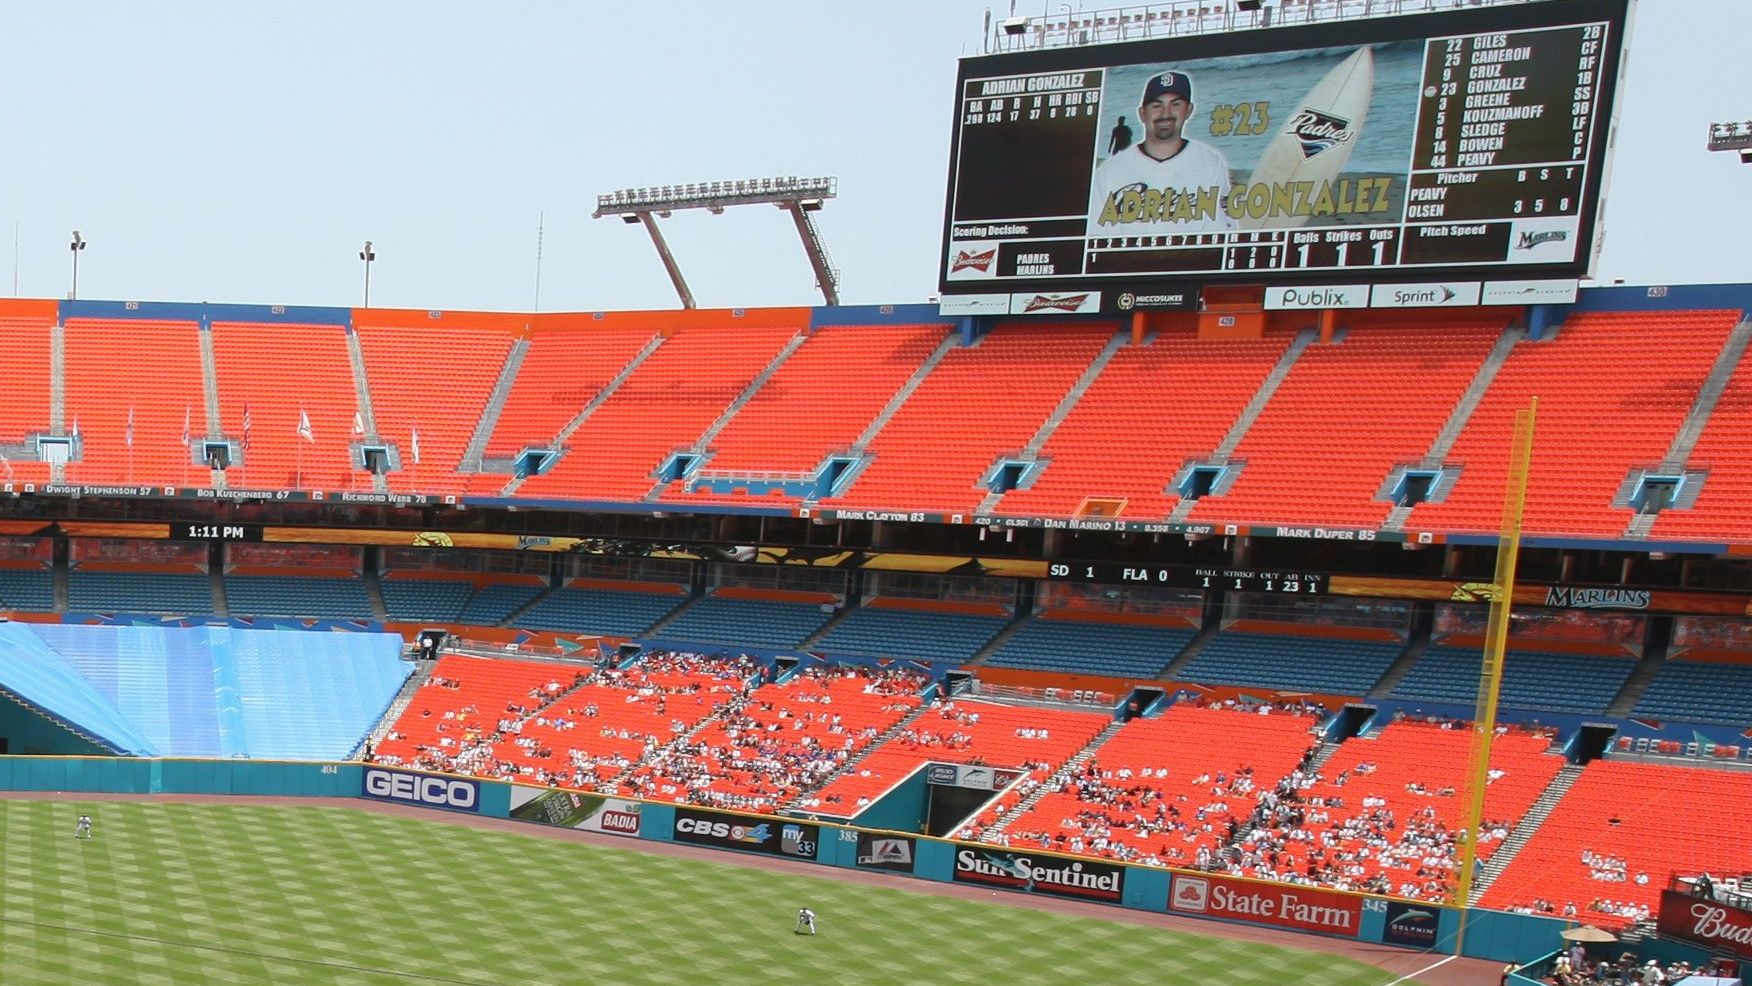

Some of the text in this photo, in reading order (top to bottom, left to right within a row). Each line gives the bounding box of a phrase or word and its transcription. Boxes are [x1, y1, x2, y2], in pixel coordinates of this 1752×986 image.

[1474, 34, 1507, 49] GILES
[1472, 47, 1530, 65] CAMERON
[1470, 64, 1502, 79] CRUZ
[982, 74, 1085, 95] ADRIAN GONZALEZ
[1467, 77, 1526, 94] GONZALEZ
[1065, 93, 1082, 105] RBI
[1465, 93, 1511, 108] GREENE
[1010, 111, 1019, 121] 17
[1209, 101, 1271, 136] #23
[1463, 105, 1544, 123] KOUZMANOFF
[1287, 113, 1355, 142] Padres
[1461, 122, 1505, 137] SLEDGE
[1459, 137, 1503, 152] BOWEN
[1457, 152, 1495, 166] PEAVY
[1437, 173, 1478, 184] Pitcher
[1411, 187, 1448, 201] PEAVY
[1098, 177, 1391, 227] ADRIAN GONZALEZ
[1408, 204, 1444, 218] OLSEN
[954, 225, 1028, 237] Scoring Decision:
[1294, 230, 1393, 244] Balls Strikes Outs
[1420, 224, 1487, 237] Pitch Speed
[1017, 254, 1049, 264] PADRES
[1017, 265, 1054, 275] MARLINS
[1283, 289, 1344, 306] Publix
[1394, 290, 1435, 305] Sprint
[46, 485, 150, 496] DWIGHT STEPHENSON 57
[197, 490, 213, 498] BOB
[277, 491, 289, 499] 67
[837, 510, 924, 522] MARK CLAYTON 83
[189, 525, 243, 538] 1:11 PM
[1044, 519, 1126, 531] DAN MARINO 13
[1276, 527, 1375, 541] MARK DUPER 85
[1545, 586, 1649, 609] MARLINS
[321, 765, 337, 774] 404
[366, 770, 476, 808] GEICO
[603, 814, 637, 829] BADIA
[676, 818, 730, 838] CBS
[782, 825, 804, 844] my
[838, 830, 858, 842] 385
[799, 841, 814, 855] 33
[958, 850, 1120, 892] Sun Sentinel
[1211, 885, 1350, 928] State Farm
[1362, 899, 1387, 912] 345
[1392, 924, 1434, 935] DOLPHIN
